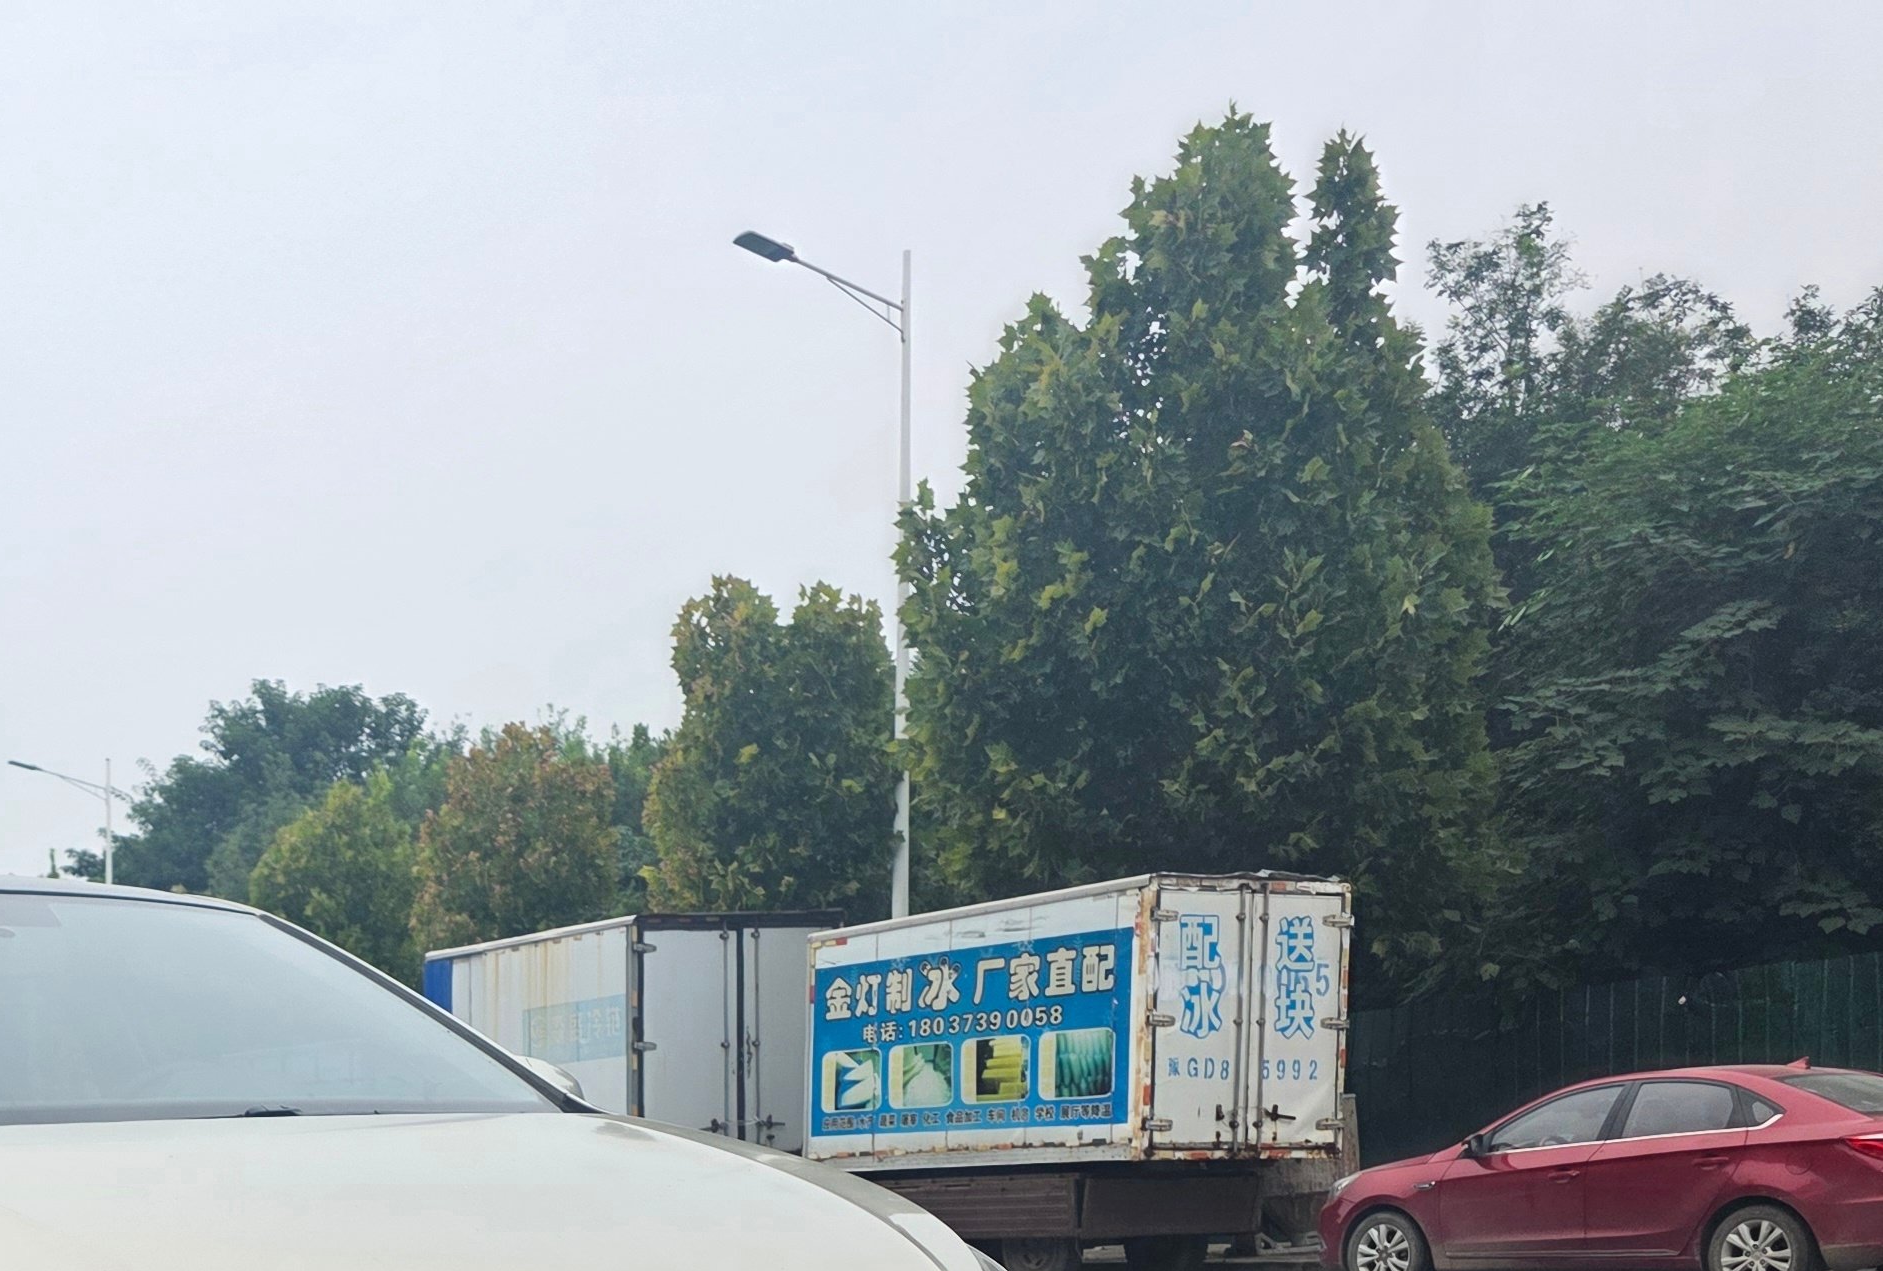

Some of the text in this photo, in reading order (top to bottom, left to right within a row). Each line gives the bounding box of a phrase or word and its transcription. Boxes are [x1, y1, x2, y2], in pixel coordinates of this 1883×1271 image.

[825, 944, 1115, 1021] 金灯制冰 厂家直配
[946, 1108, 982, 1125] 食品加工
[1035, 1104, 1055, 1121] 学校
